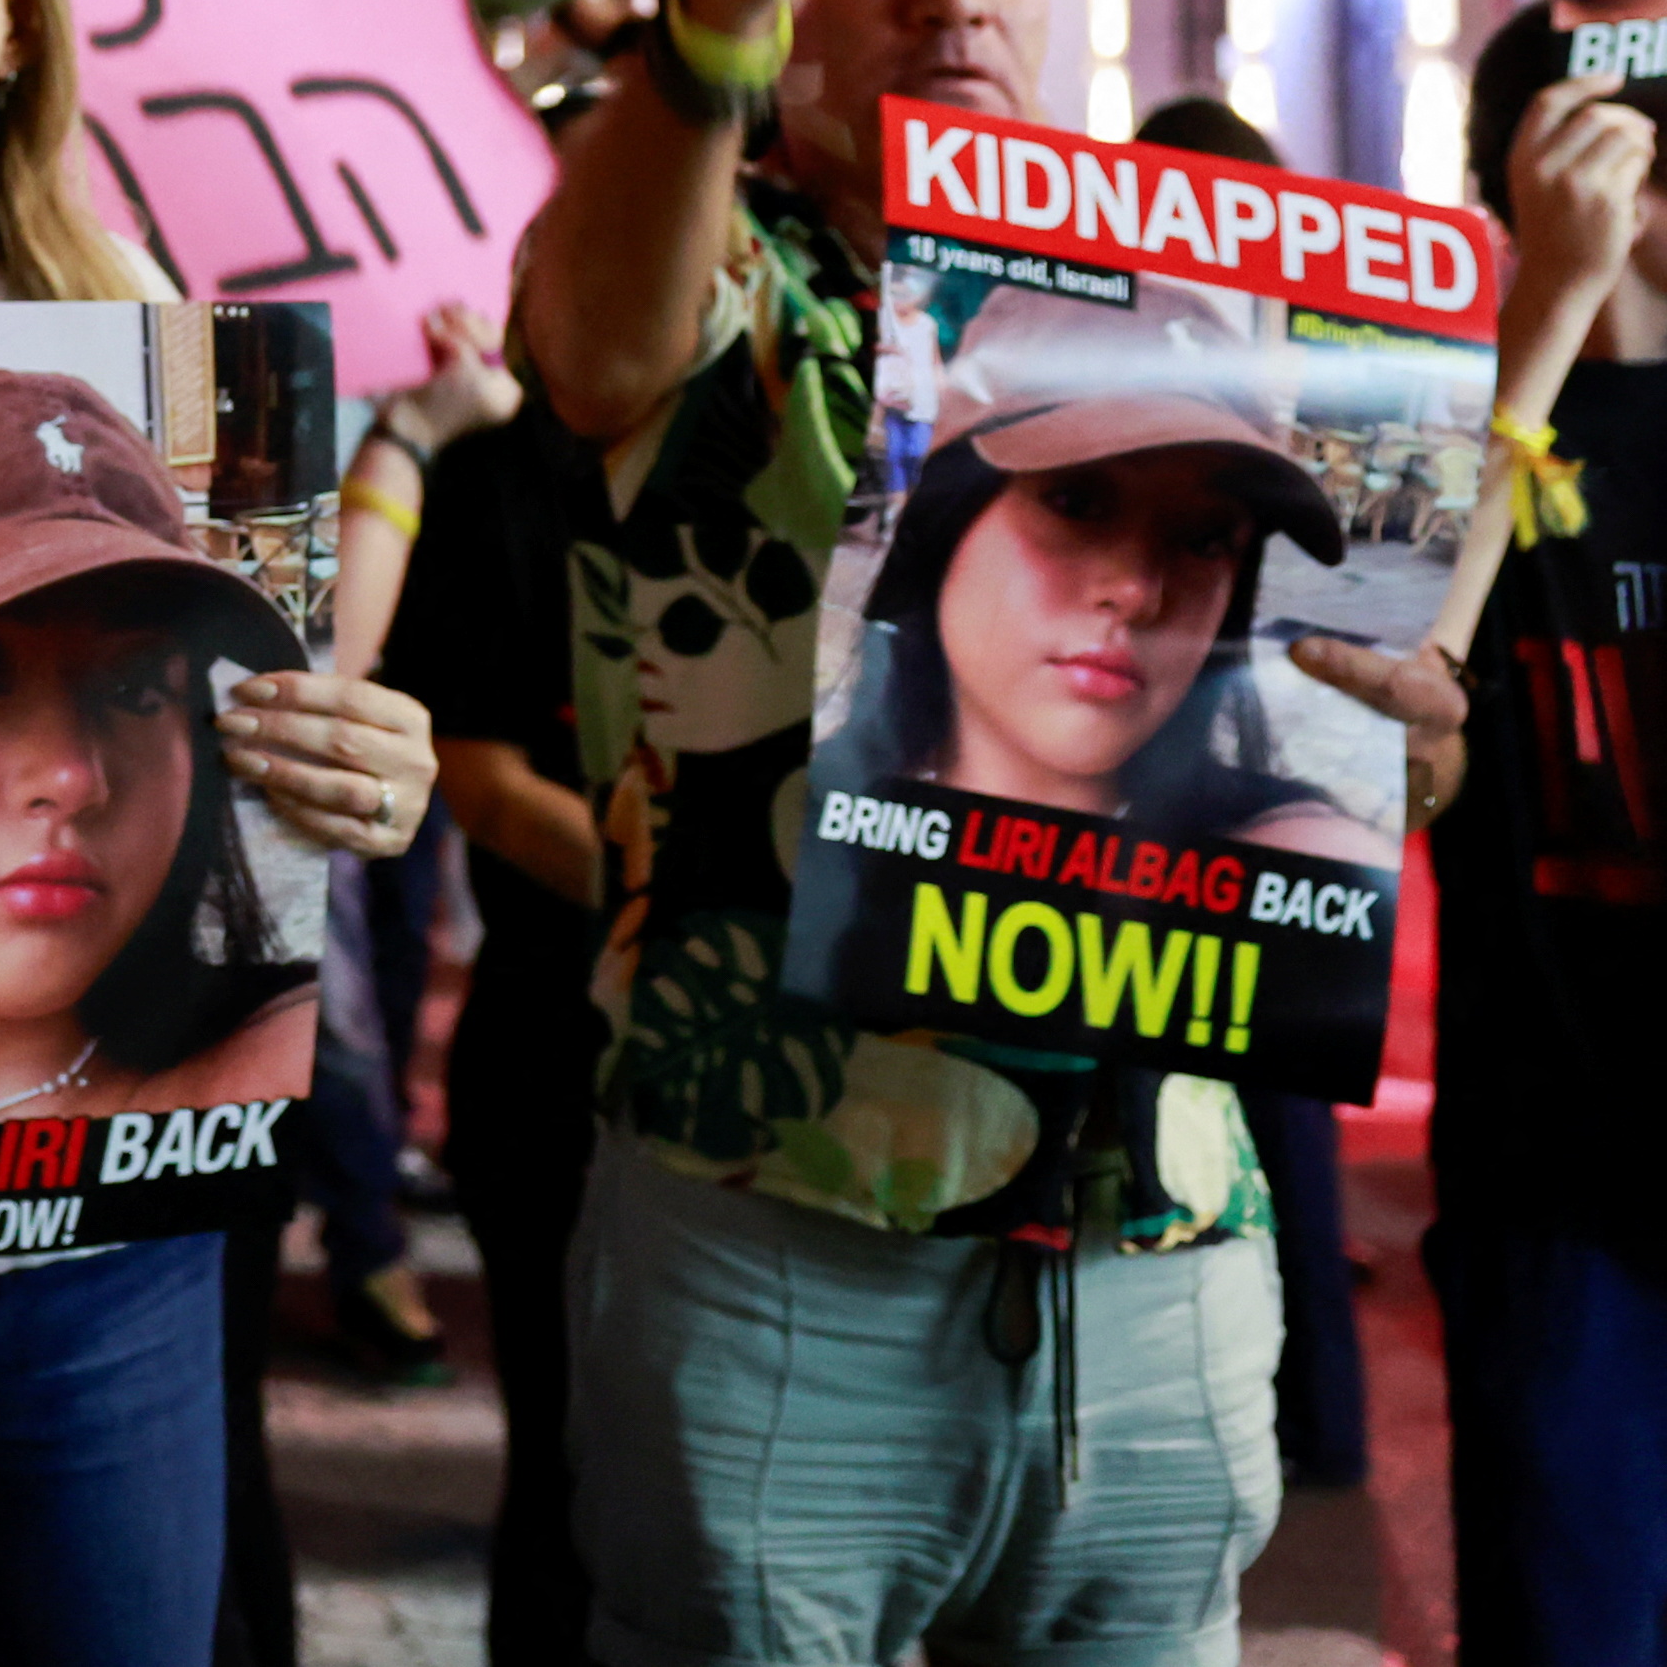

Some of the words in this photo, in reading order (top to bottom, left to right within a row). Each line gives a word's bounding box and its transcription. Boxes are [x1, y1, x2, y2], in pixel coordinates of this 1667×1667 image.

[904, 119, 1479, 313] KIDNAPPED
[938, 245, 1004, 273] years
[1055, 263, 1129, 301] Israeli
[818, 790, 952, 860] BRING
[957, 809, 1061, 879] LIRI
[1059, 830, 1246, 914] ALBAG
[1249, 872, 1378, 940] BACK
[903, 881, 1261, 1054] NOW!!
[99, 1098, 290, 1185] BACK
